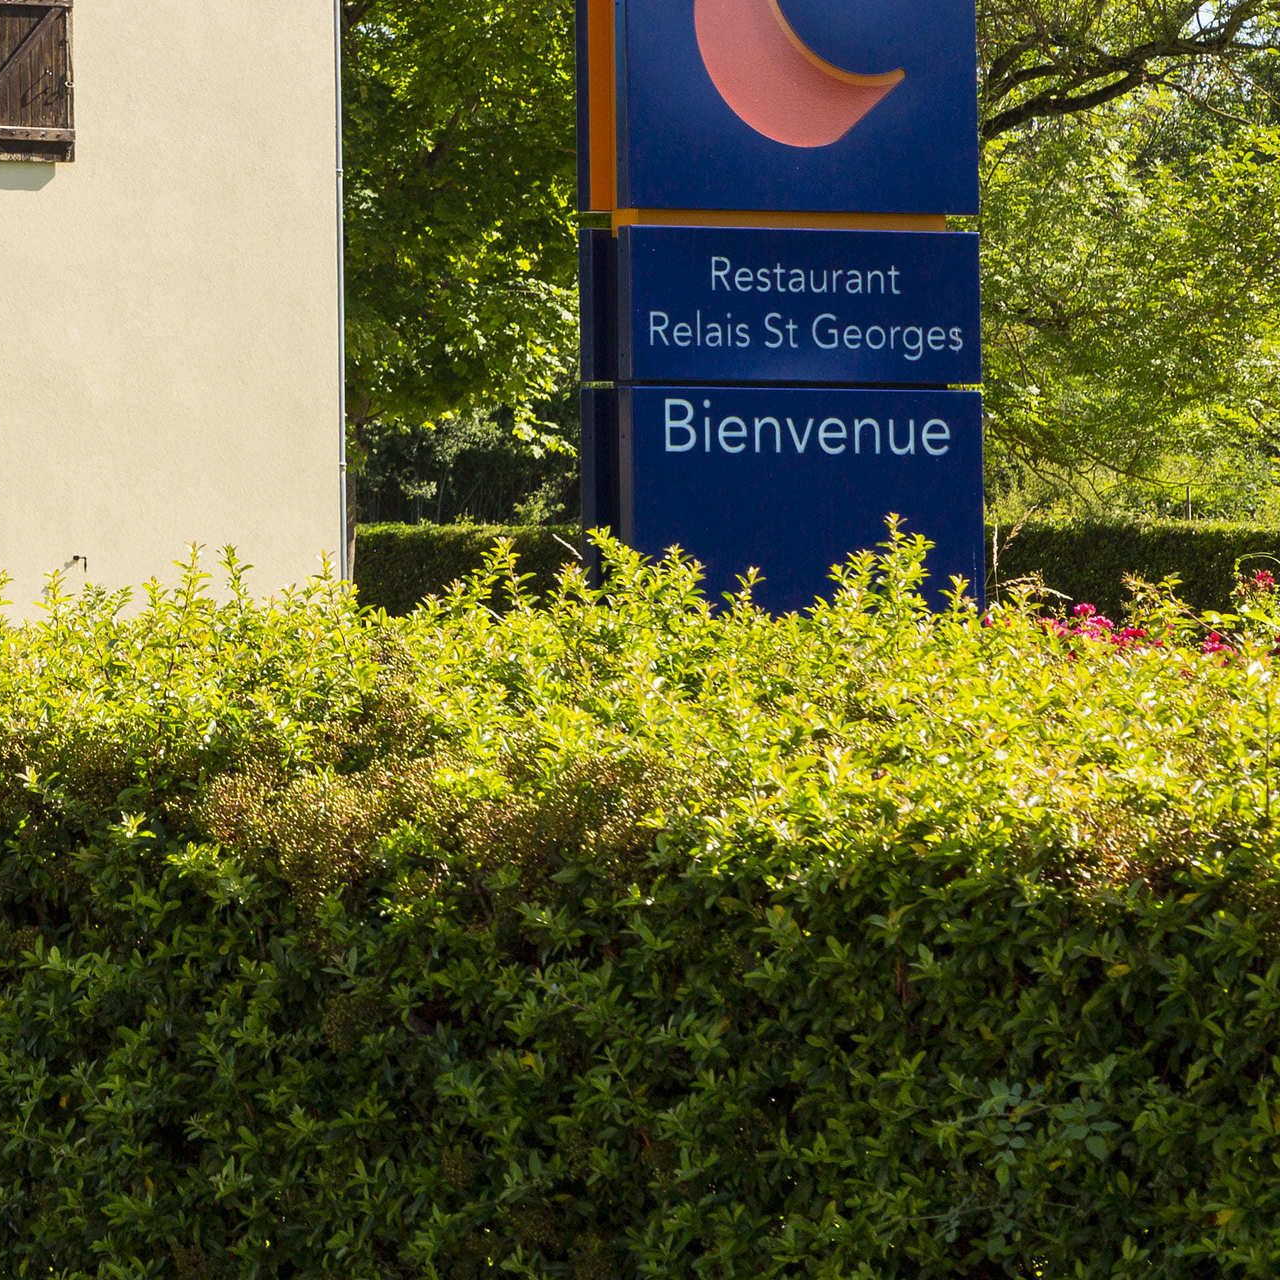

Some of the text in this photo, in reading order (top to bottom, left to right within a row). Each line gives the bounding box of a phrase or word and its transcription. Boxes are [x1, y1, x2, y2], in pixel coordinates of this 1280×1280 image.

[711, 256, 901, 295] Restaurant
[649, 311, 963, 361] Relais St Georges
[665, 399, 951, 456] Bienvenue
